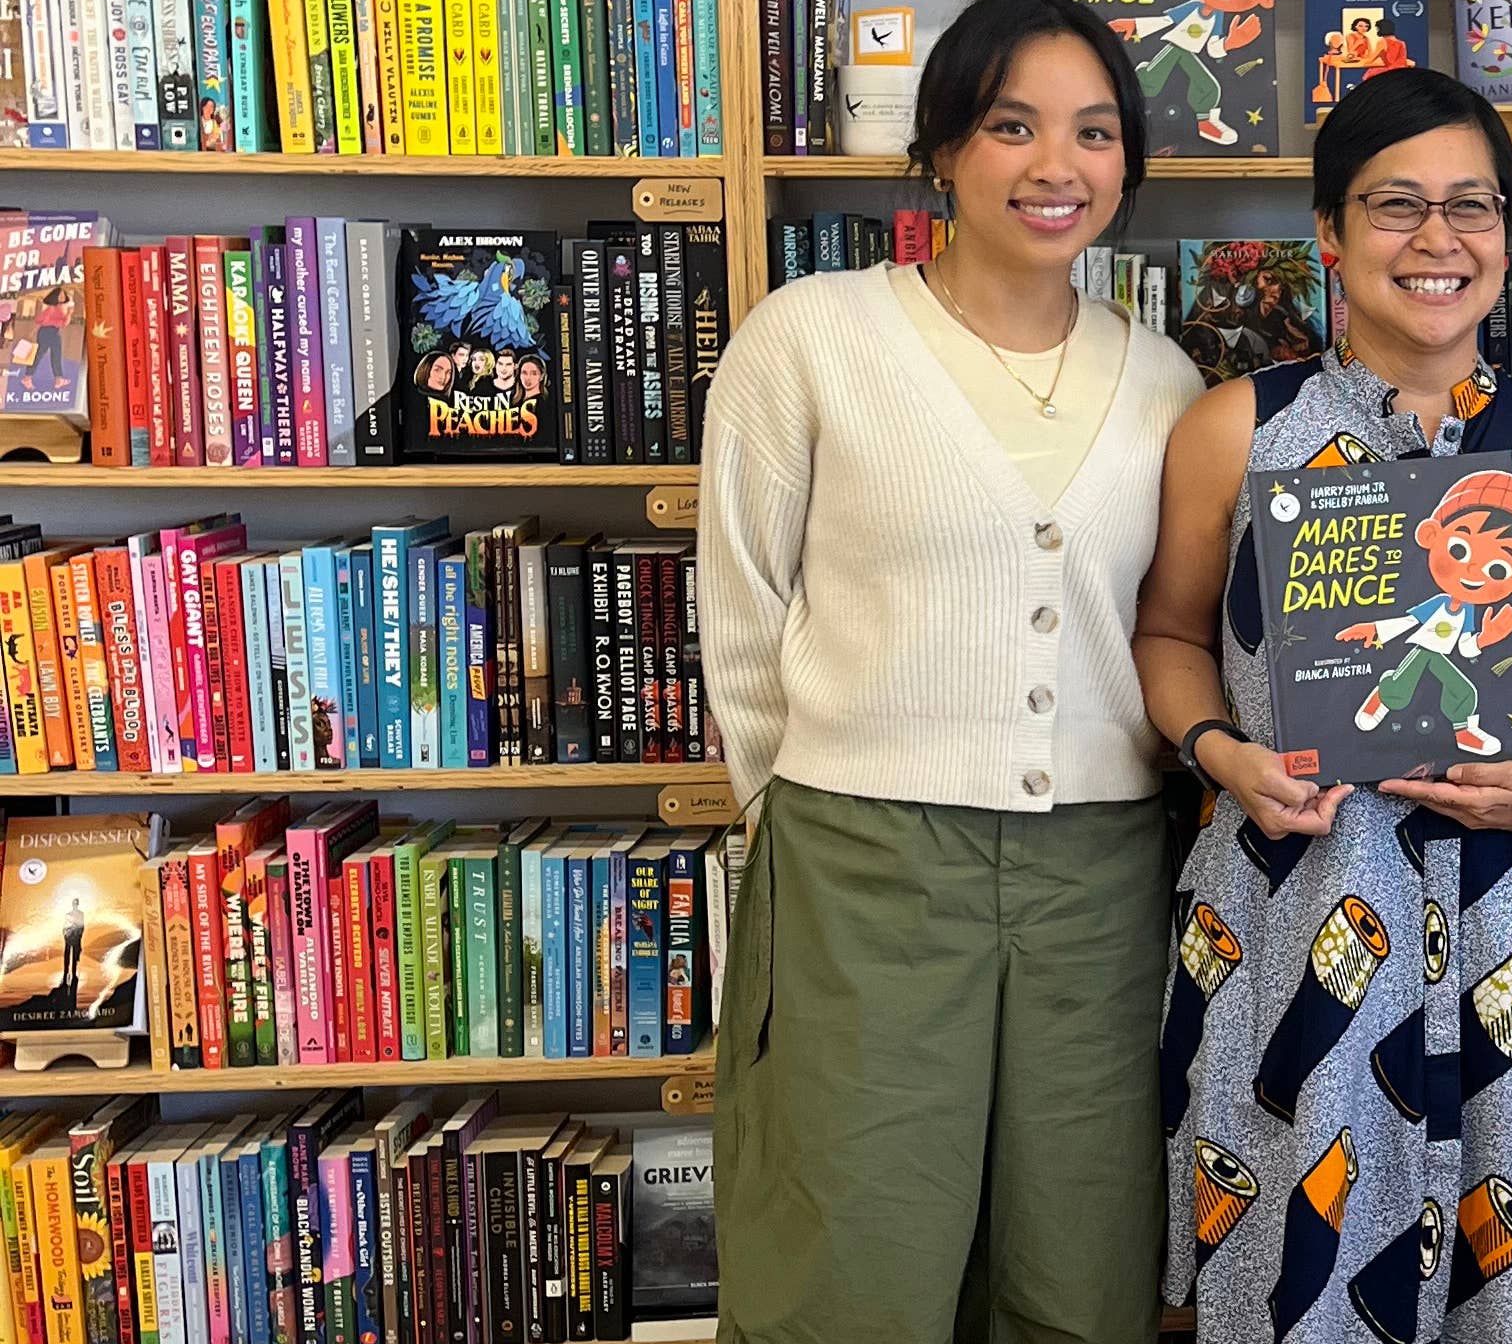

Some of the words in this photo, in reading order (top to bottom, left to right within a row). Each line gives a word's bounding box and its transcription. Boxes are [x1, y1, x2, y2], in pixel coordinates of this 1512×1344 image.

[417, 3, 431, 14] A
[417, 16, 435, 81] PROMISE
[814, 37, 825, 102] MANZANAR
[9, 230, 34, 248] BE
[41, 223, 92, 240] GONE
[291, 227, 304, 245] my
[439, 235, 473, 247] ALEX
[476, 235, 522, 247] BROWN
[5, 251, 40, 268] FOR
[291, 250, 306, 292] mother
[169, 252, 188, 316] MAMA
[200, 263, 221, 365] EIGHTEEN
[230, 260, 252, 347] KARAOKE
[295, 295, 309, 336] cursed
[298, 340, 311, 364] my
[28, 391, 70, 402] BOONE
[235, 351, 253, 411] QUEEN
[301, 365, 311, 394] name
[207, 372, 224, 436] ROSES
[428, 398, 538, 438] PEACHES
[454, 392, 490, 411] REST
[494, 392, 511, 409] IN
[1311, 487, 1344, 498] HARRY
[1345, 484, 1370, 495] SHUM
[1372, 482, 1385, 492] JR
[1311, 500, 1316, 508] &
[1318, 496, 1354, 508] SHELBY
[1355, 493, 1389, 505] RABARA
[1293, 513, 1406, 548] MARTEE
[1290, 545, 1380, 578] DARES
[1386, 550, 1402, 561] TO
[593, 563, 609, 622] EXHIBIT
[616, 565, 632, 626] PAGEBOY
[1283, 573, 1399, 612] DANCE
[381, 538, 401, 687] HE/SHE/THEY
[619, 646, 635, 693] ELLIOT
[1295, 667, 1329, 682] BIANCA
[1332, 663, 1371, 677] AUSTRIA
[621, 696, 636, 731] PAGE
[19, 829, 140, 848] DISPOSSESSED
[631, 877, 658, 888] SHARE
[636, 867, 654, 877] OUR
[472, 871, 488, 944] TRUST
[631, 898, 659, 910] NIGHT
[640, 889, 651, 898] OF
[73, 1154, 98, 1204] Soil
[379, 1192, 390, 1228] SISTER
[382, 1231, 394, 1286] OUTSIDER
